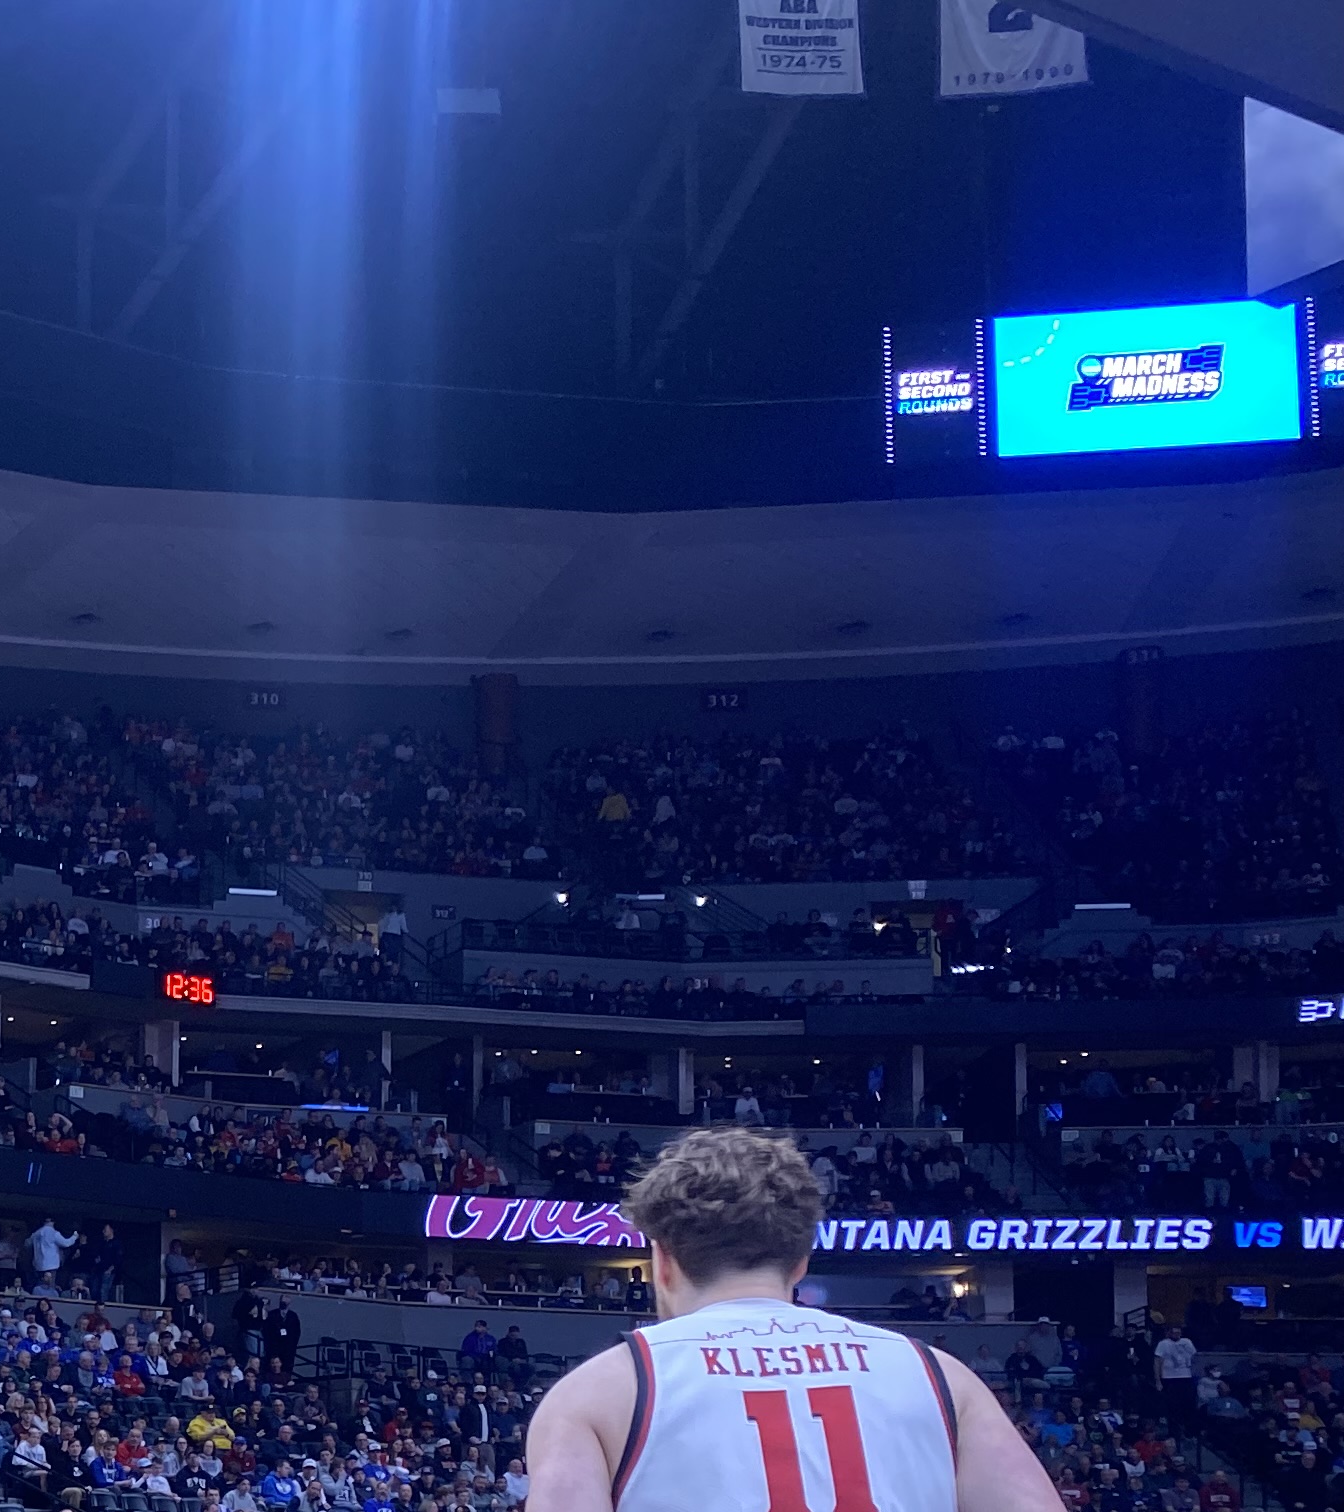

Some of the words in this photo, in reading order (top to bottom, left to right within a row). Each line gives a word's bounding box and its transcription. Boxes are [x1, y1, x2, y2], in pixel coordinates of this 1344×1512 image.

[762, 33, 838, 47] CHAMPIONS
[761, 54, 843, 70] 1974-75
[1101, 352, 1182, 379] MARCH
[898, 370, 954, 387] FIRST
[1110, 370, 1221, 399] MADNESS
[898, 383, 972, 400] SECOND
[897, 397, 973, 415] ROUNDS
[166, 973, 214, 1004] 12:36
[812, 1218, 954, 1251] NTANA
[966, 1218, 1214, 1251] GRIZZLIES
[1233, 1220, 1285, 1249] VS
[699, 1342, 871, 1378] KLESMIT
